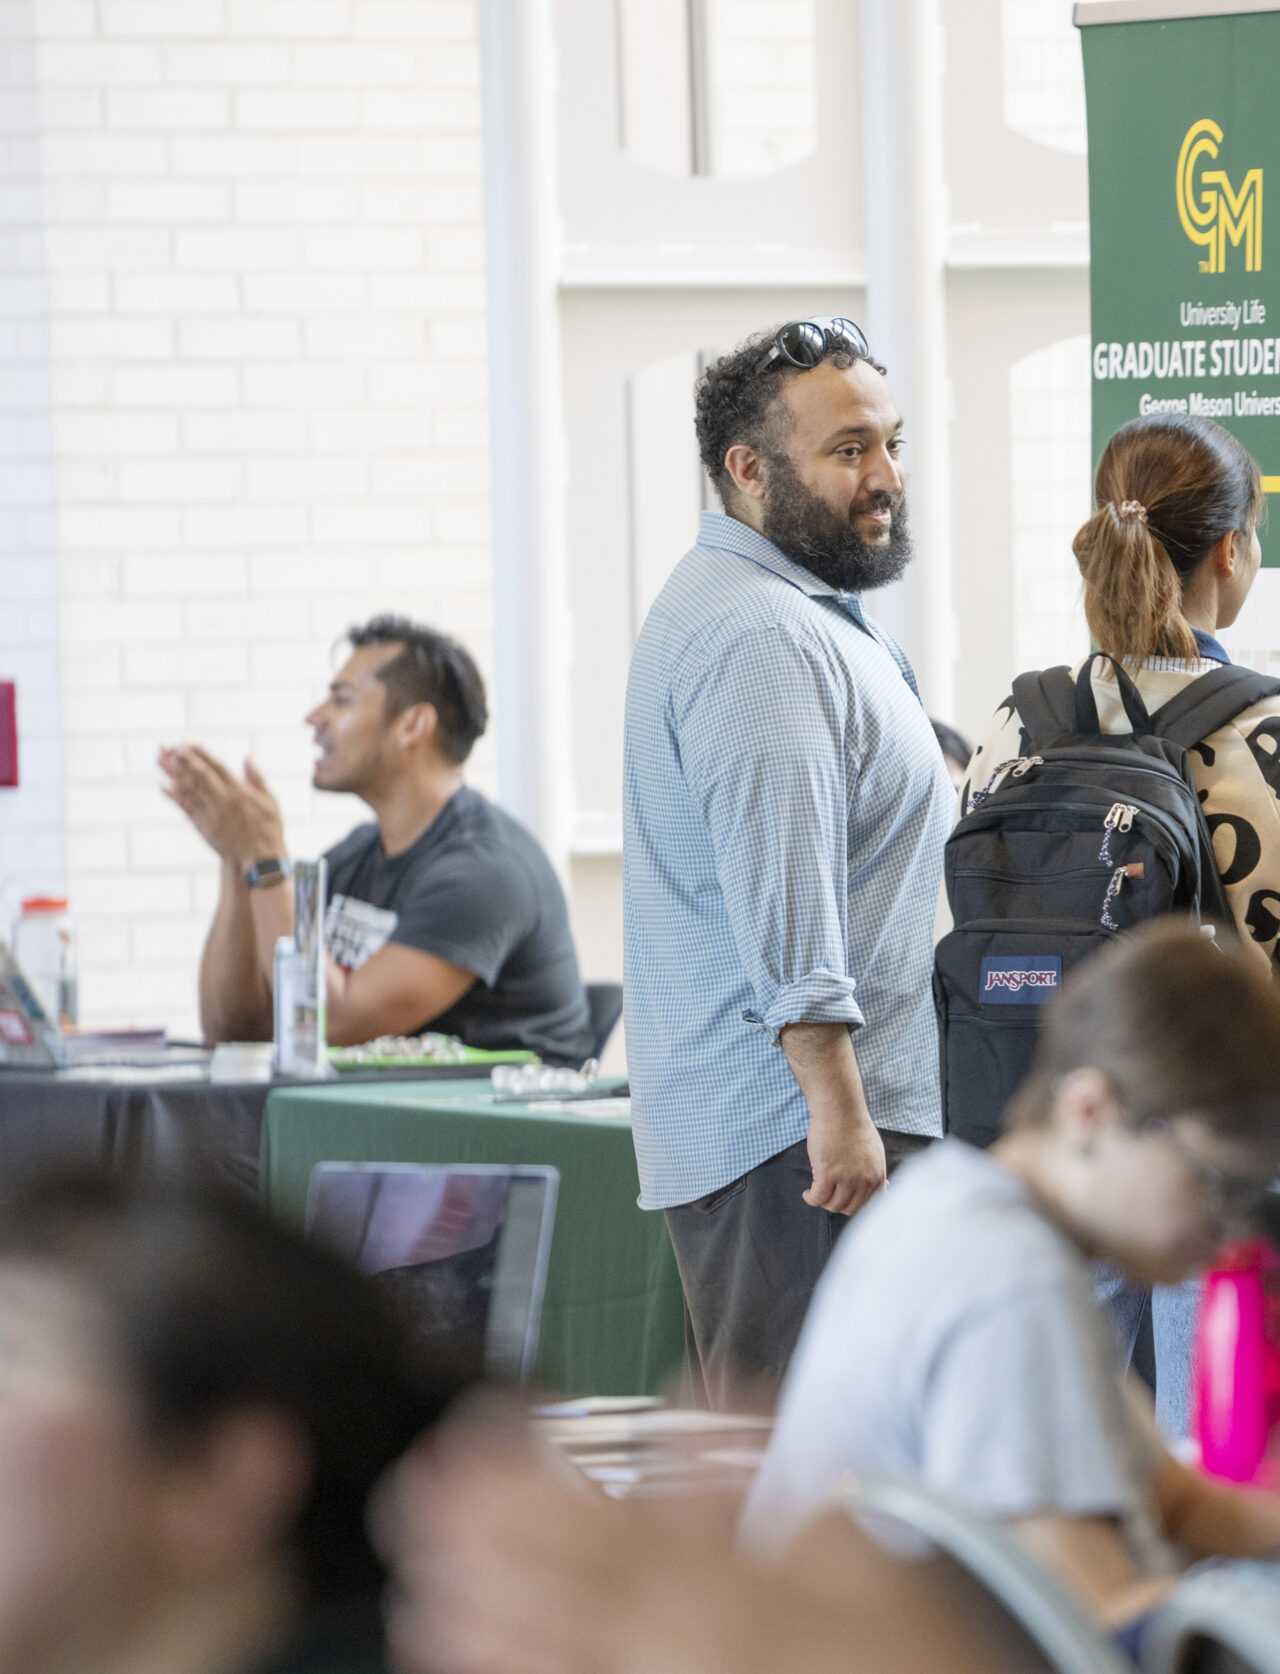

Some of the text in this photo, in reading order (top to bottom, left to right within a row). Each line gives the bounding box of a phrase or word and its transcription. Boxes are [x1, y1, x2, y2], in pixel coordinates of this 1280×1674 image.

[1180, 300, 1266, 330] University Life
[1093, 340, 1206, 380] GRADUATE
[1189, 392, 1232, 417] Mason
[984, 970, 1057, 992] JANSPORT
